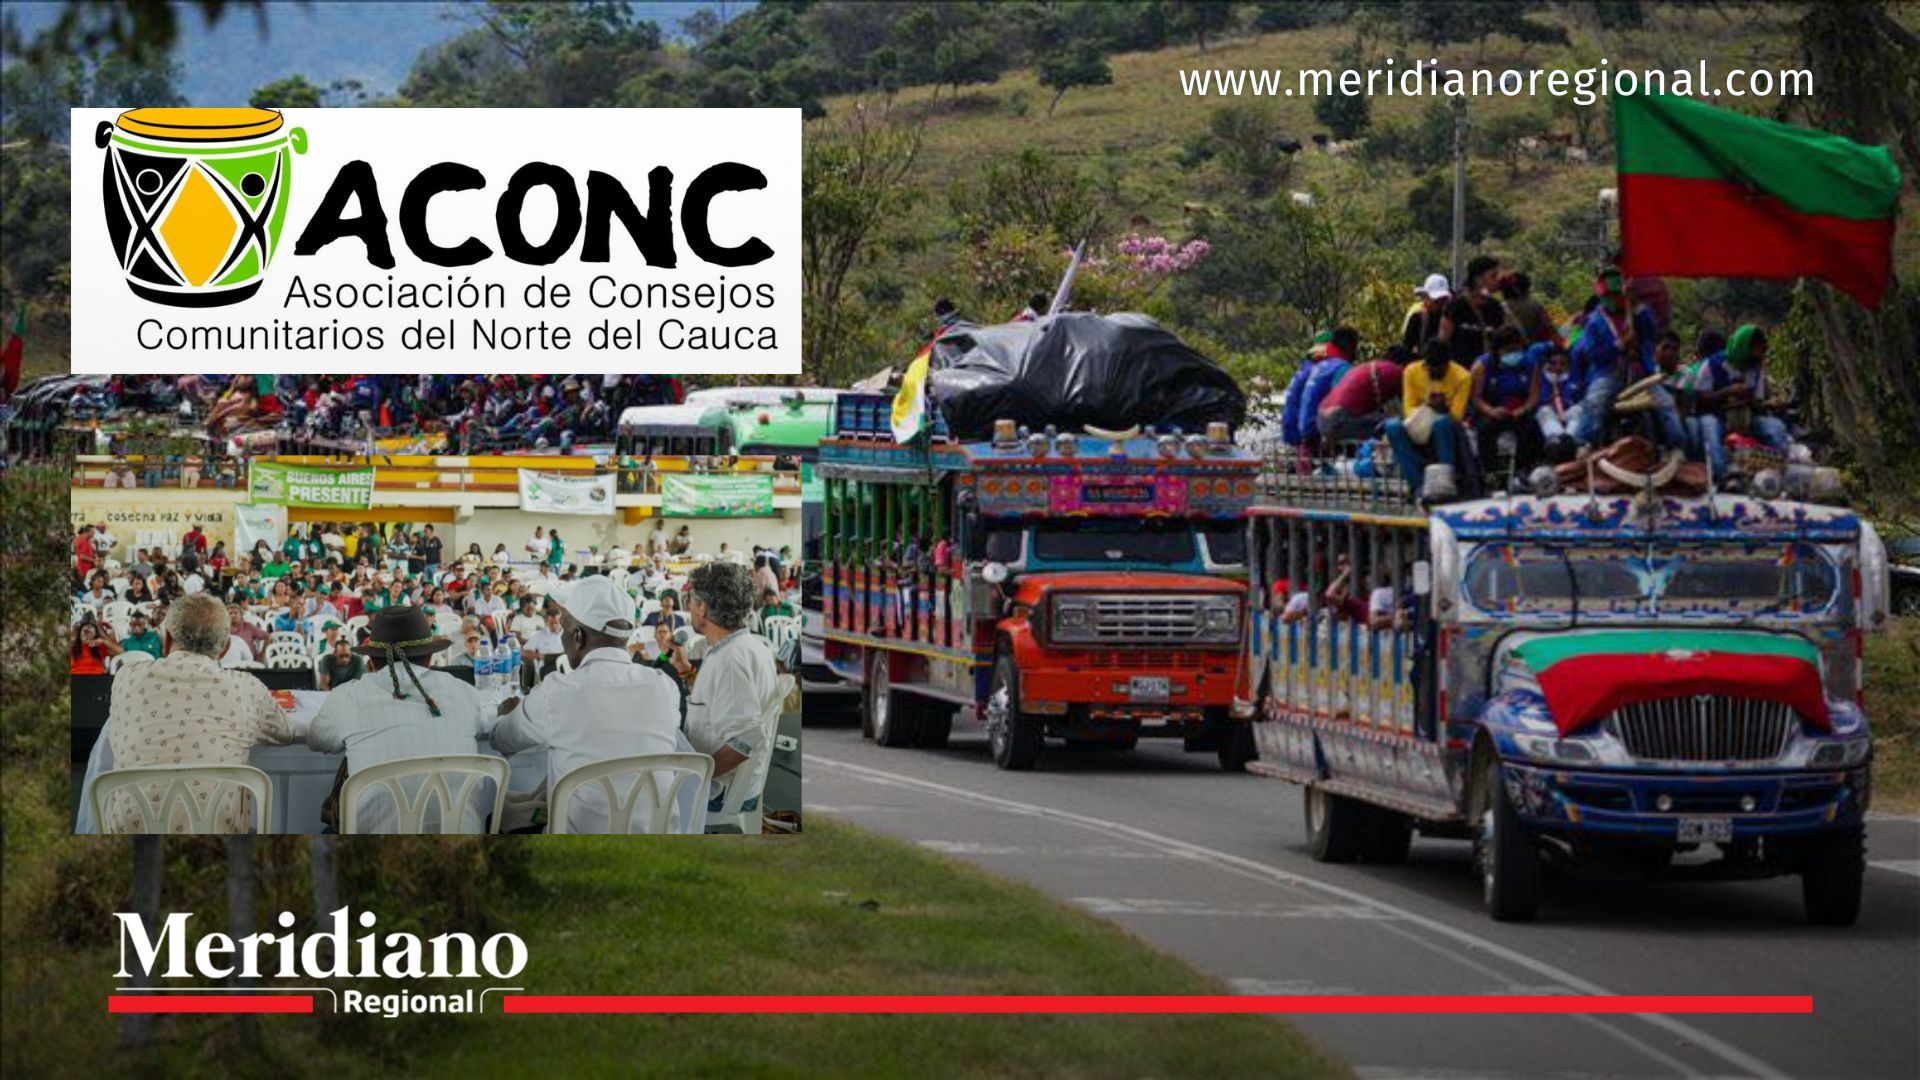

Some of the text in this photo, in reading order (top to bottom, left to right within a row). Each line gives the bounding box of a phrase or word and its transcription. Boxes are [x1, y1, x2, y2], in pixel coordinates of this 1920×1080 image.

[286, 471, 373, 486] BUENOS AIRES
[289, 485, 370, 504] PRESENTE
